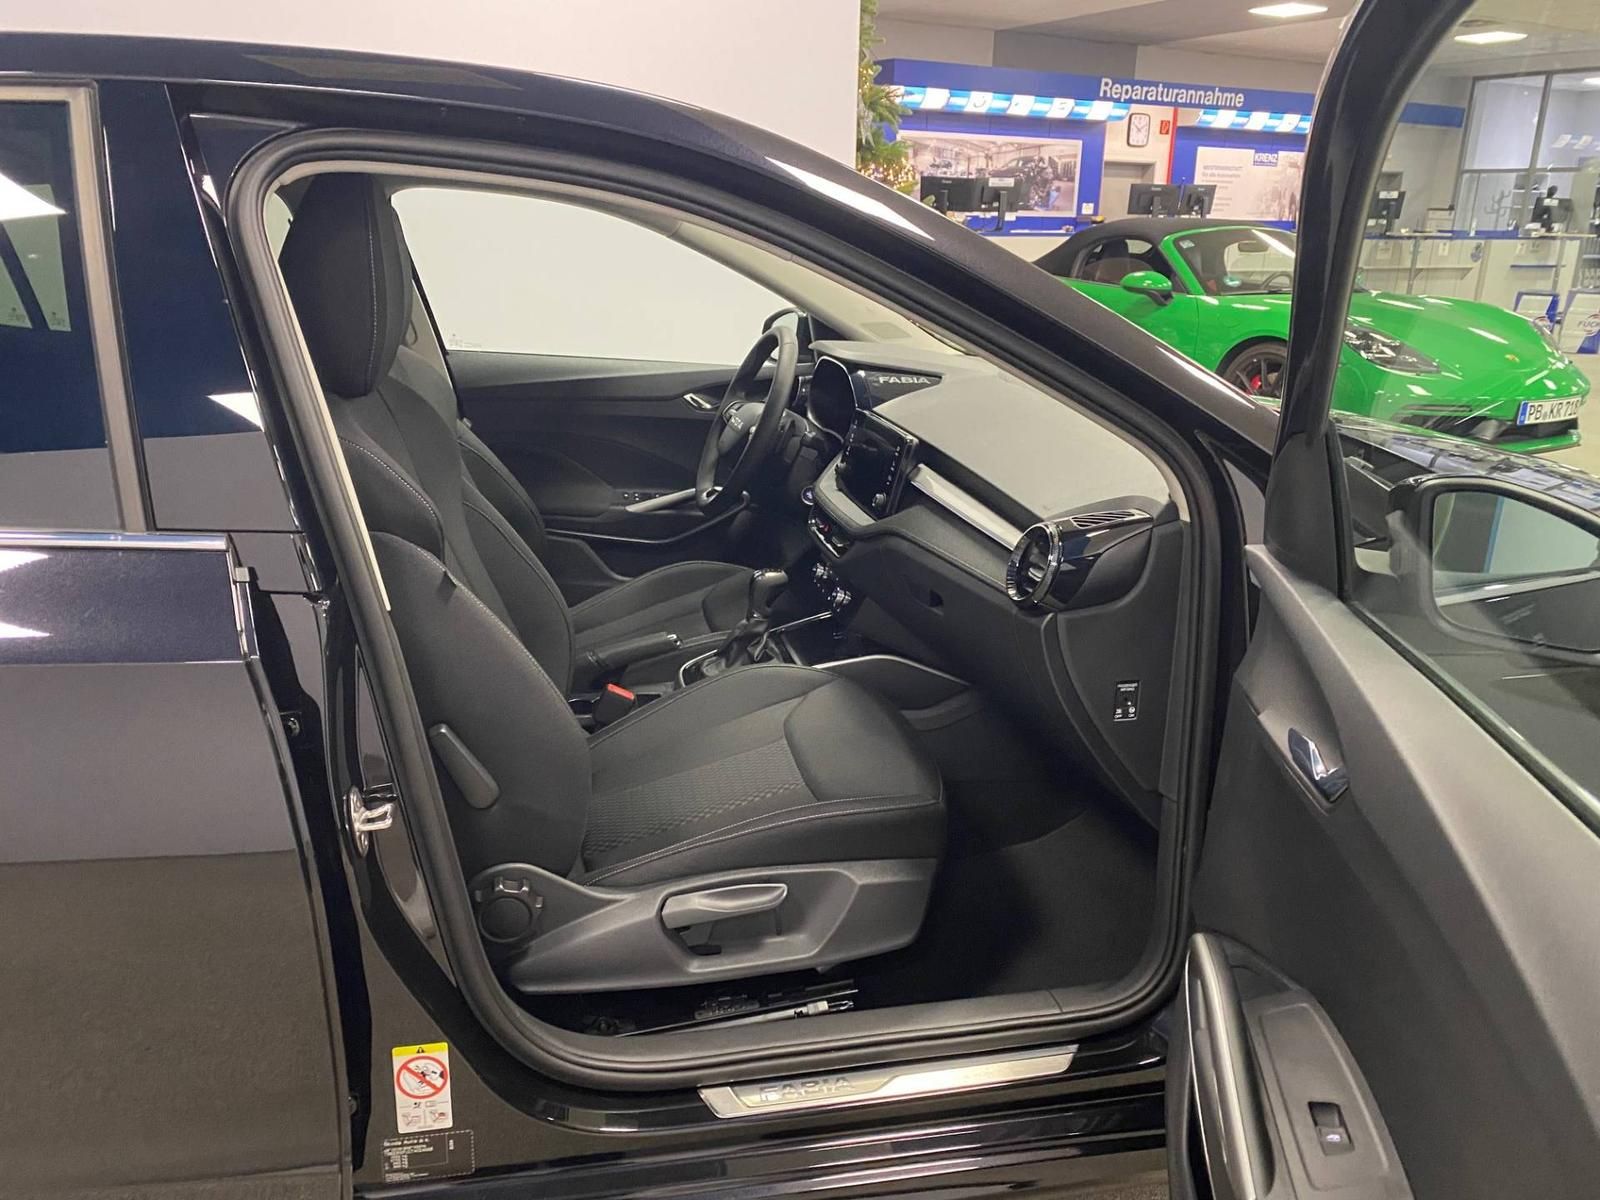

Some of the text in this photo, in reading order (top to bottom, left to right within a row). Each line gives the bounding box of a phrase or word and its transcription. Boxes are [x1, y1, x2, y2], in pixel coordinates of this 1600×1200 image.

[1100, 77, 1244, 107] Reparaturannahme
[879, 376, 931, 384] FABIA
[1528, 404, 1543, 420] PB
[1549, 401, 1564, 419] KR
